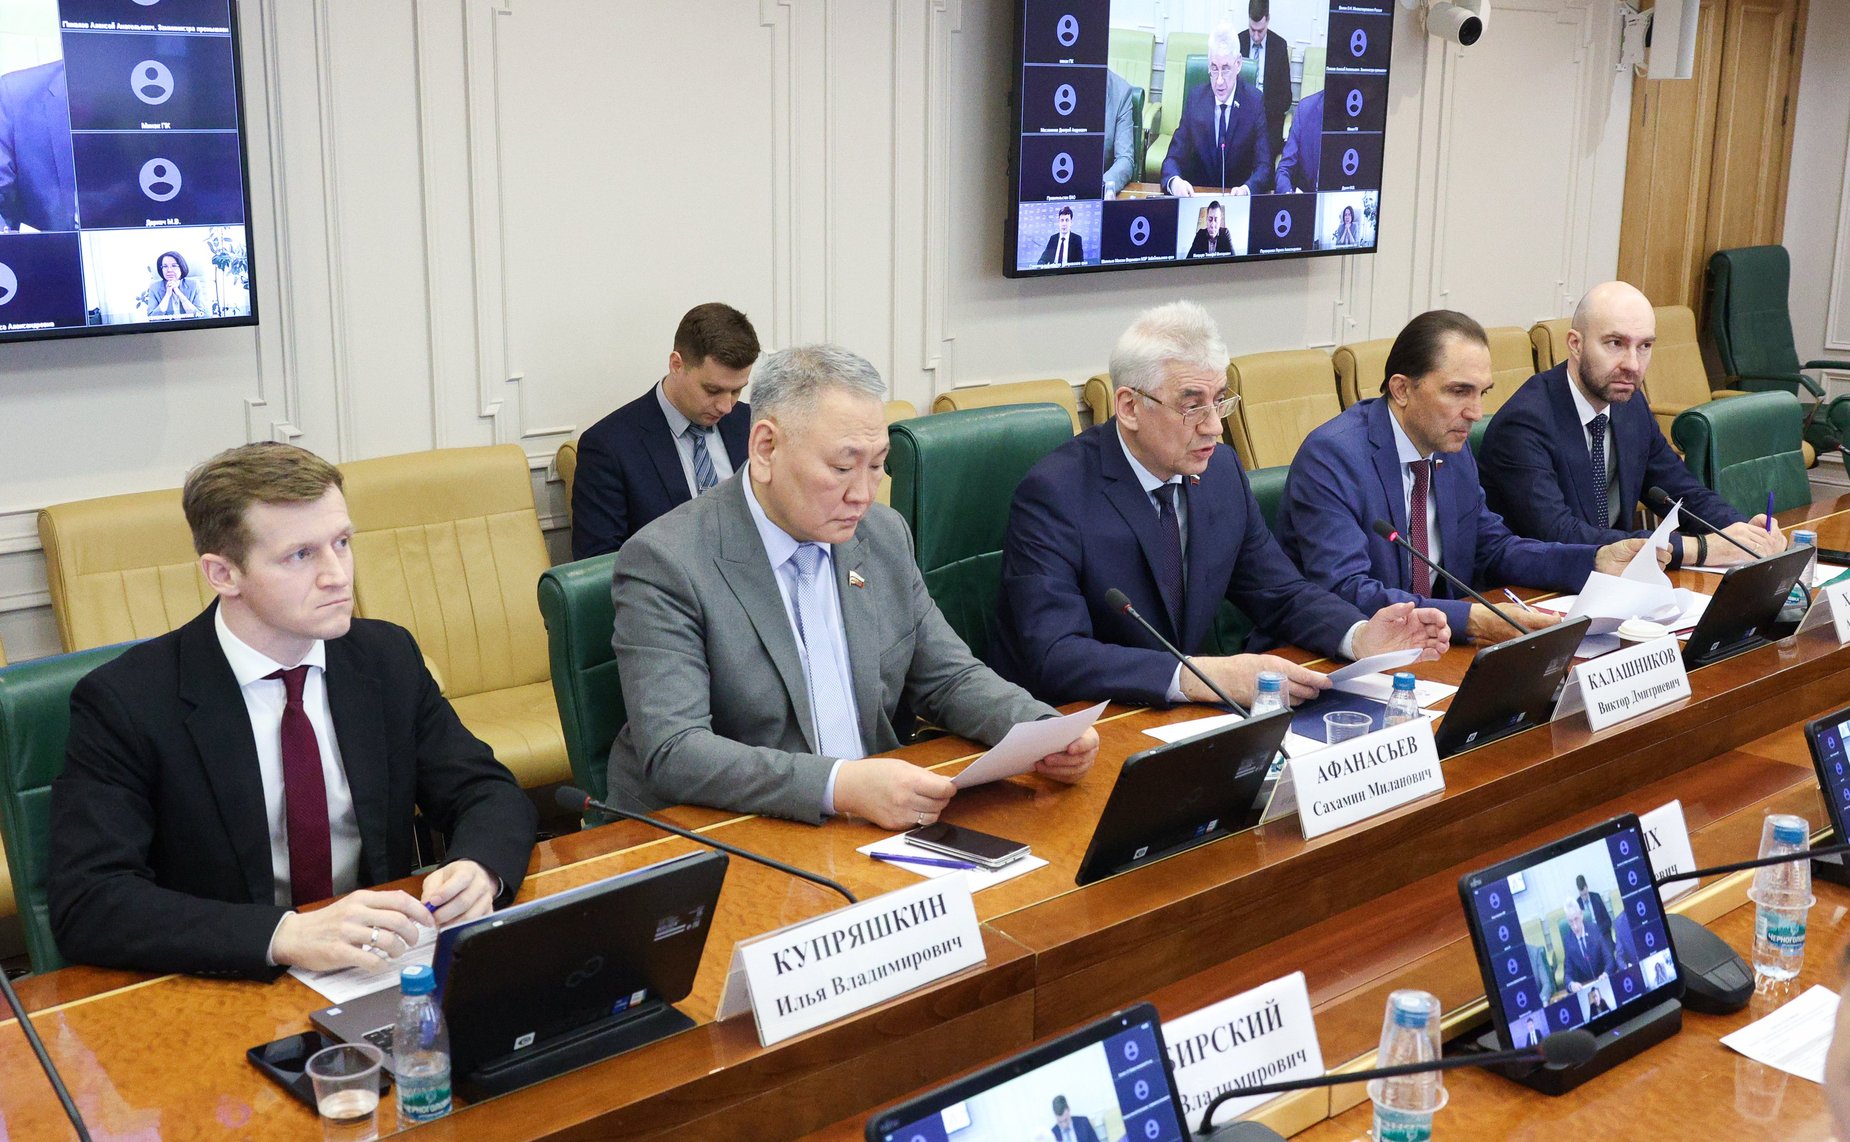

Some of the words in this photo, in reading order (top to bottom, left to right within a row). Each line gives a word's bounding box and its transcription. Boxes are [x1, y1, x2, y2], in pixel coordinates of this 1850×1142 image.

[1587, 647, 1676, 690] КАЛАШНИКОВ
[1598, 696, 1630, 715] Виктор
[1631, 678, 1681, 705] Дмитриевич
[1317, 735, 1418, 784] АФАНАСЬЕВ
[1313, 790, 1366, 817] Сахамин
[1368, 768, 1432, 799] Миланович
[772, 893, 948, 977] КУПРЯШКИН
[776, 986, 827, 1017] Илья
[831, 936, 963, 995] Владимирович
